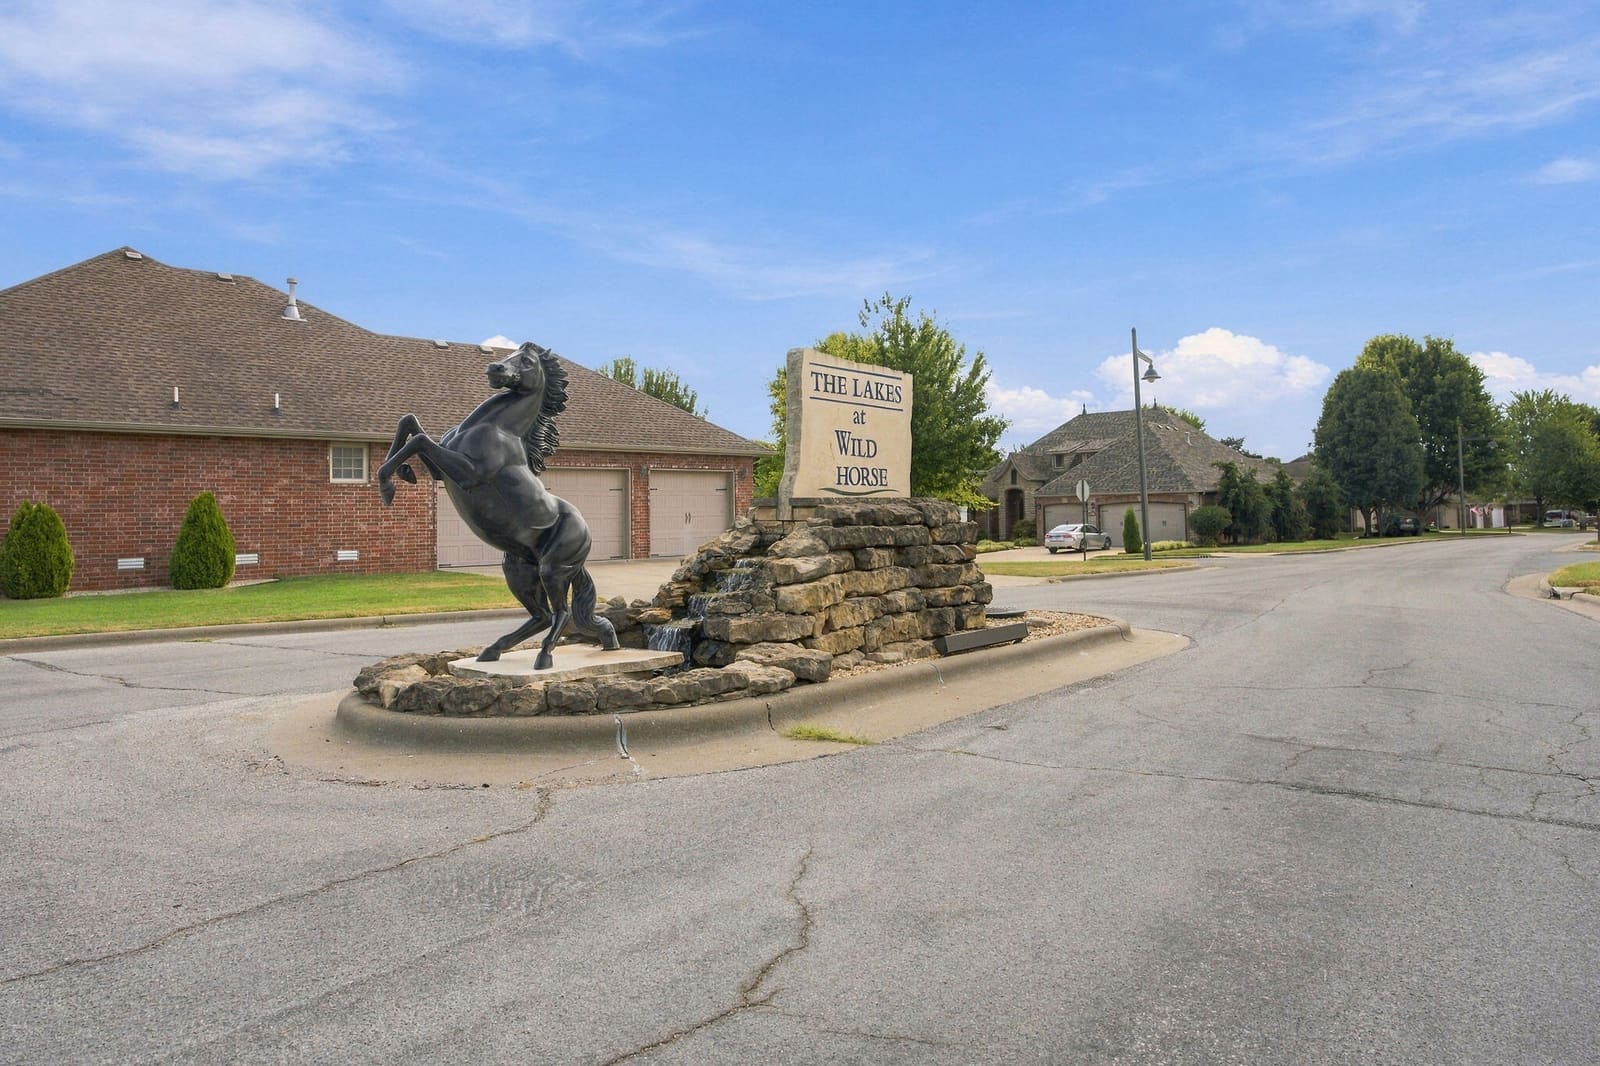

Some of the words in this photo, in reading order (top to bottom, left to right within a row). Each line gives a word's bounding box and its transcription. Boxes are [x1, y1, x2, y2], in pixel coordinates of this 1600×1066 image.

[811, 371, 847, 395] THE
[853, 378, 902, 403] LAKES
[853, 409, 866, 425] at
[835, 430, 877, 458] WILD
[836, 466, 888, 486] HORSE
